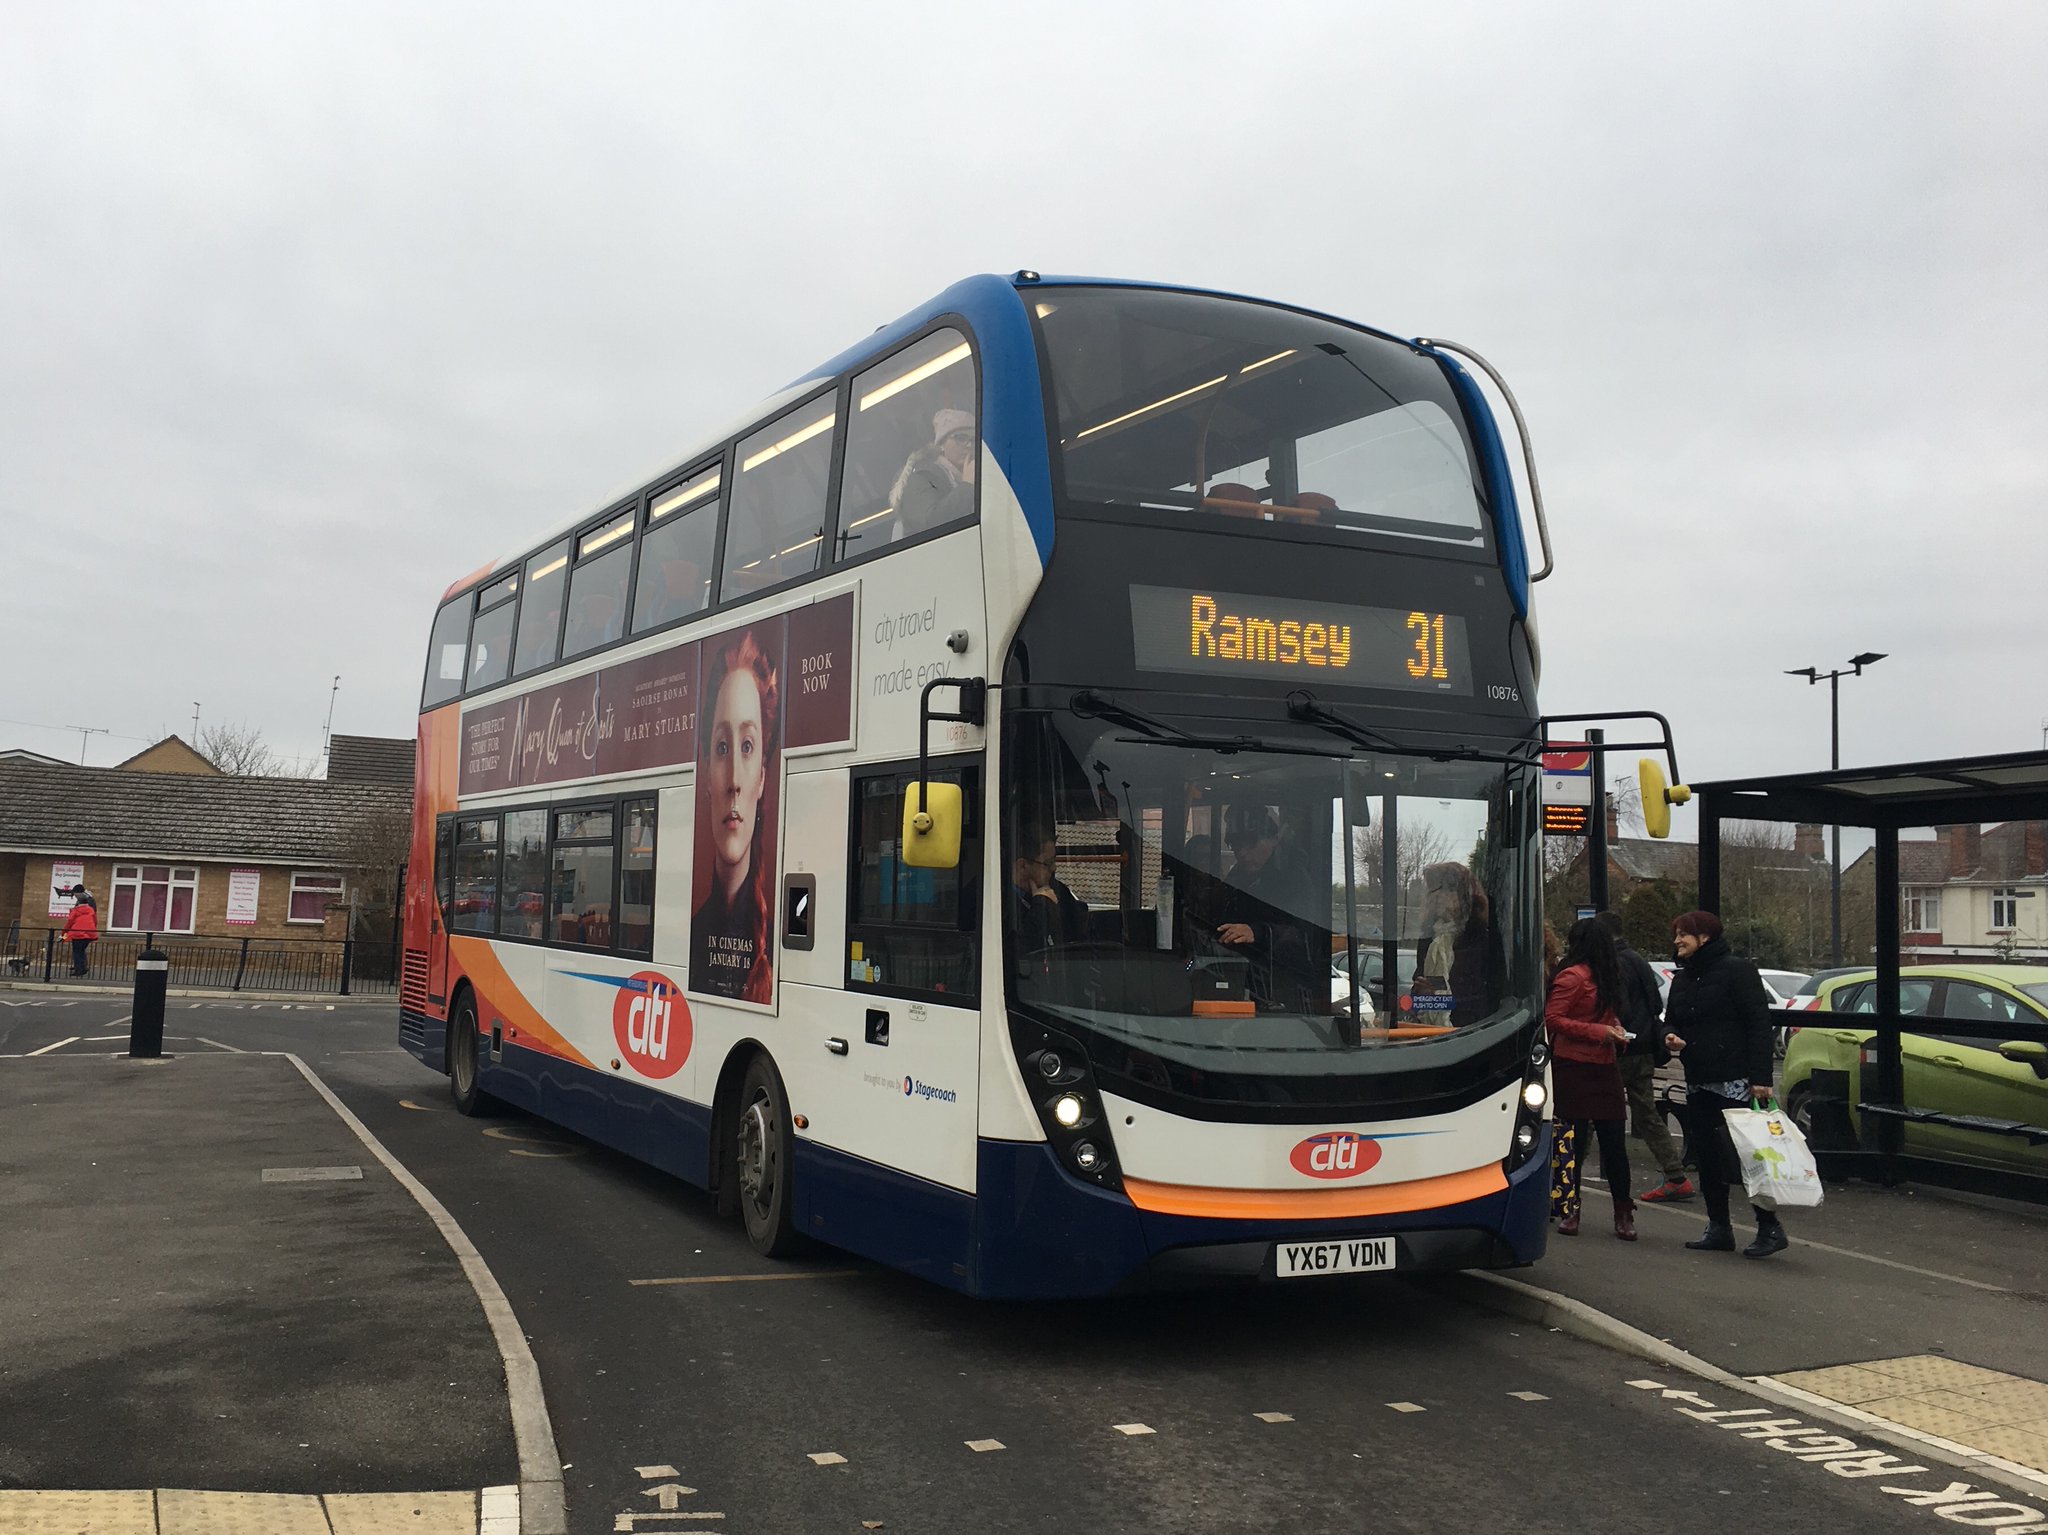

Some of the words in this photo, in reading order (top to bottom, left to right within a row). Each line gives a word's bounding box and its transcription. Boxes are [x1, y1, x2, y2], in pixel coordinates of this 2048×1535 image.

[875, 612, 897, 651] city
[899, 597, 936, 638] travel
[1191, 594, 1350, 667] Ramsey
[1407, 611, 1448, 678] 31
[801, 652, 832, 674] BOOK
[802, 673, 830, 694] NOW
[873, 659, 912, 696] made
[917, 660, 951, 694] easy
[663, 684, 688, 702] RONAN
[1487, 684, 1519, 701] 10876
[623, 722, 651, 742] MARY
[654, 713, 696, 736] STUART
[946, 725, 968, 741] 10876
[508, 697, 545, 783] Mary
[708, 935, 717, 948] IN
[719, 937, 753, 953] CINEMAS
[708, 952, 742, 968] JANUARY
[743, 957, 751, 969] 18
[915, 1080, 957, 1103] Stagecoach
[1310, 1134, 1360, 1171] citi
[1286, 1244, 1342, 1272] YX67
[1348, 1241, 1387, 1267] VDN
